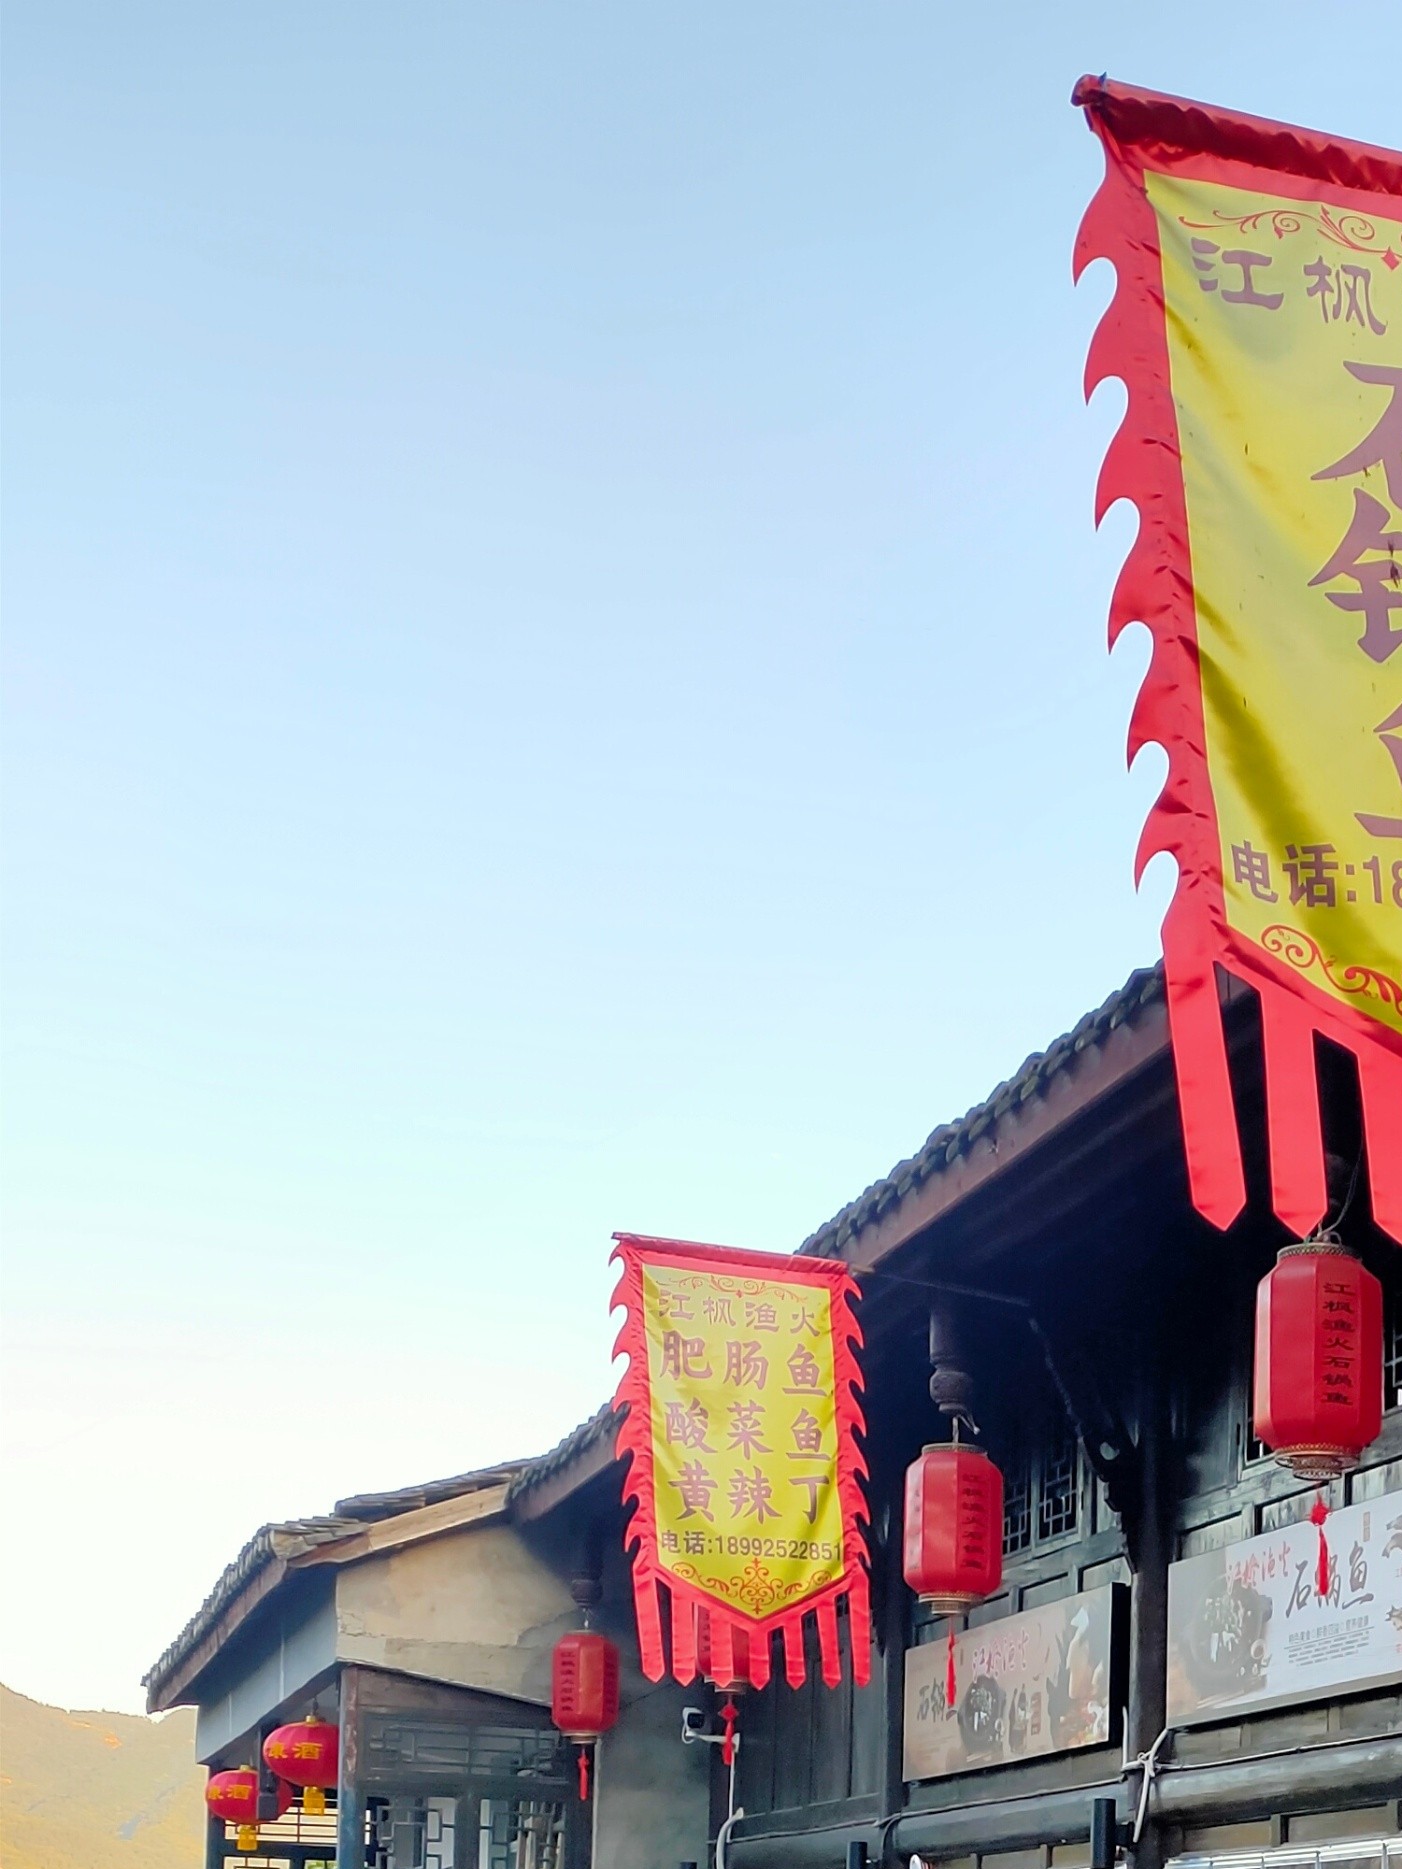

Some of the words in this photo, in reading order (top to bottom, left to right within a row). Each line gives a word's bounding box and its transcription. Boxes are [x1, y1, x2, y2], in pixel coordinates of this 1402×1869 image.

[659, 1289, 821, 1337] 江枫渔火
[660, 1330, 827, 1397] 肥肠鱼
[665, 1398, 831, 1461] 酸菜鱼
[668, 1461, 829, 1525] 黄辣丁
